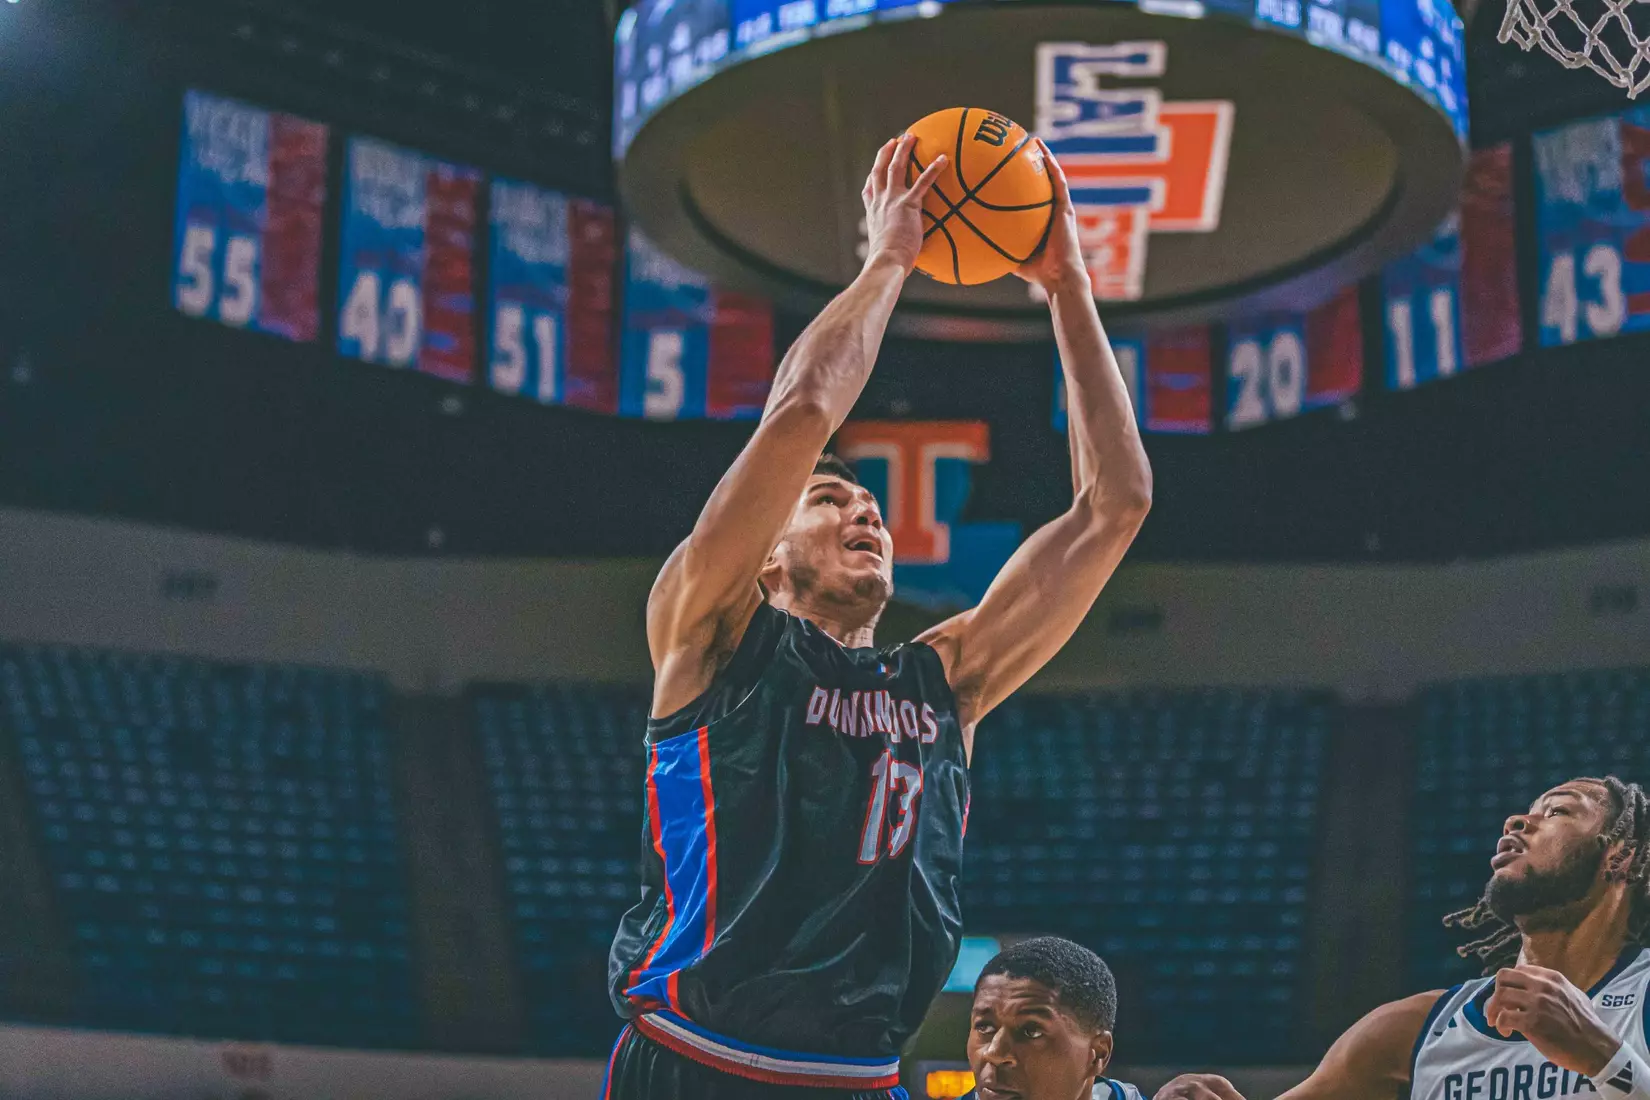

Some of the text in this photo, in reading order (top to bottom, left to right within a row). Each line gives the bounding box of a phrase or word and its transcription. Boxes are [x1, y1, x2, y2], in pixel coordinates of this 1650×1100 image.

[176, 226, 256, 326] 55
[1543, 244, 1626, 343] 43
[491, 305, 557, 405] 51
[643, 330, 685, 422] 5
[1228, 331, 1303, 431] 20
[1388, 288, 1456, 390] 11
[857, 749, 924, 865] 13
[1601, 993, 1635, 1008] SBC
[1444, 1061, 1597, 1100] GEORGIA
